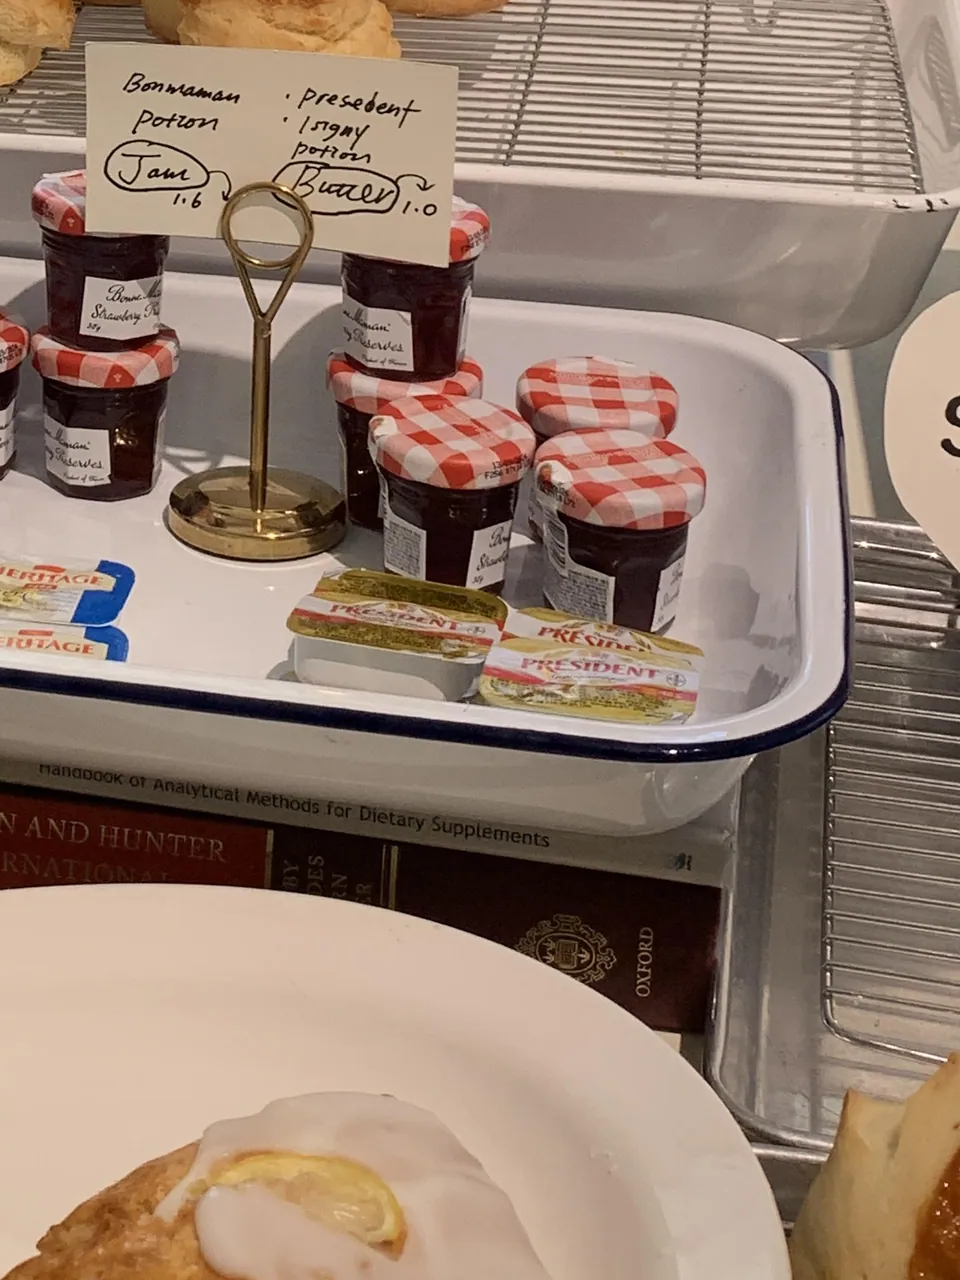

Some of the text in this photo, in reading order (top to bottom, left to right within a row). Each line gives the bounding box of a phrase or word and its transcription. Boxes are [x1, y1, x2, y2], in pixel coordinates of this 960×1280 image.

[118, 151, 192, 186] Jam
[290, 163, 396, 206] Butter
[172, 192, 203, 209] 1.6
[401, 201, 439, 217] 1.0
[39, 762, 551, 849] Handbook of Analytical Methods for Dietary Supplements
[24, 815, 91, 846] AND
[98, 824, 228, 864] HUNTER
[635, 926, 655, 998] OXFORD
